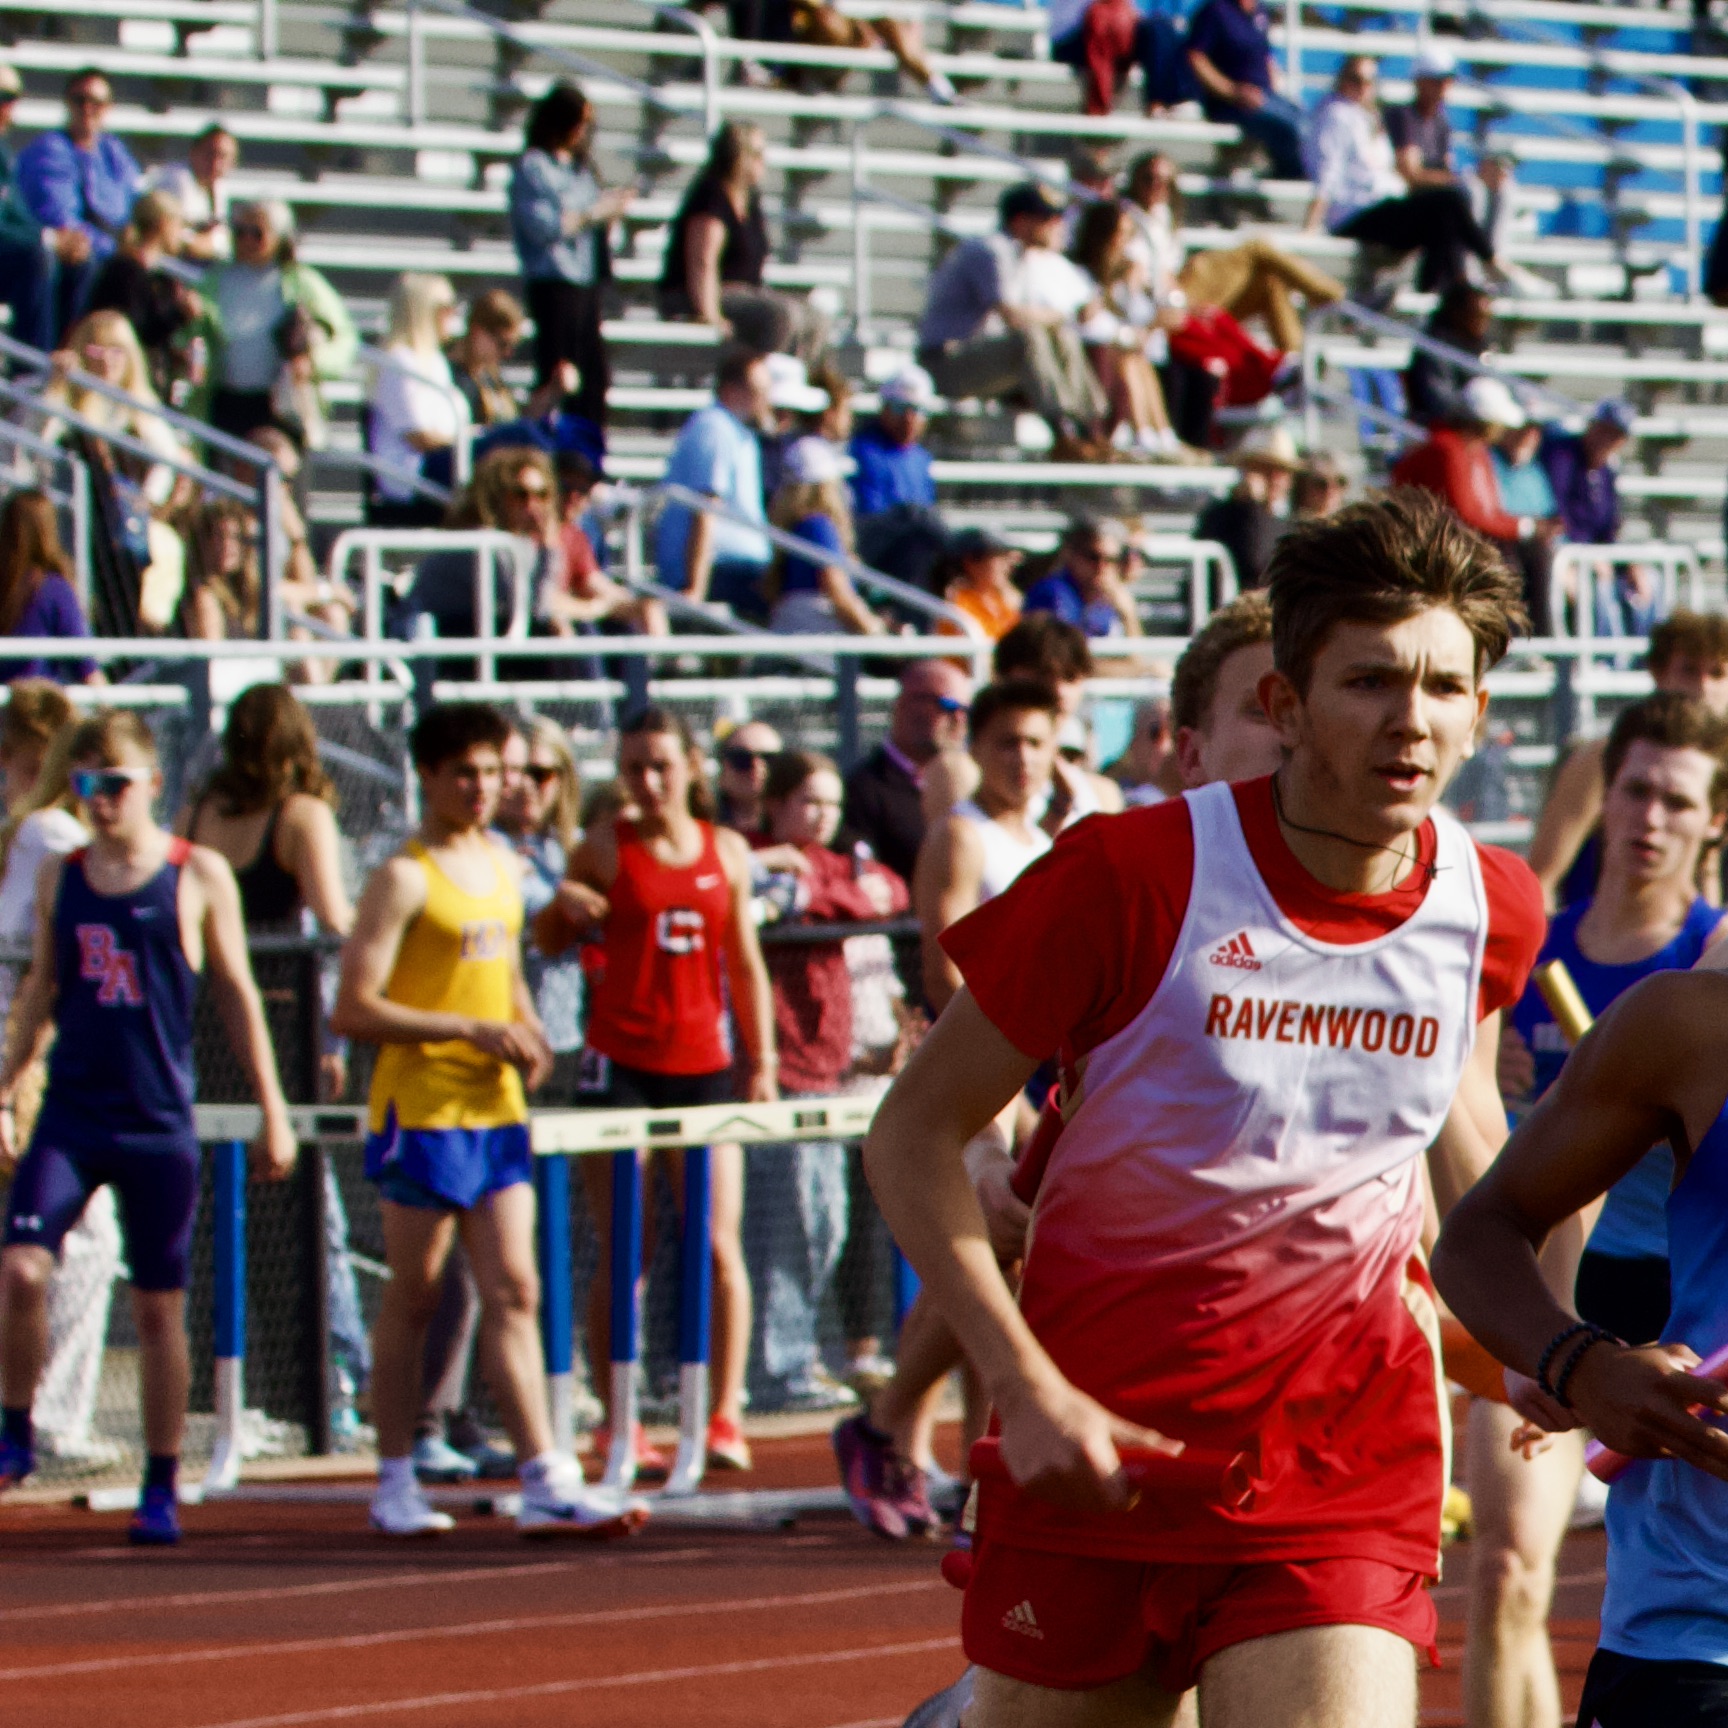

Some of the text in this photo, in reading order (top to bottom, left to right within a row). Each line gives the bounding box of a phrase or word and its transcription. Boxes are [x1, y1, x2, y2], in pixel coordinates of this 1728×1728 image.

[656, 907, 705, 954] C
[1209, 953, 1263, 972] adidas
[1204, 993, 1440, 1059] RAVENWOOD
